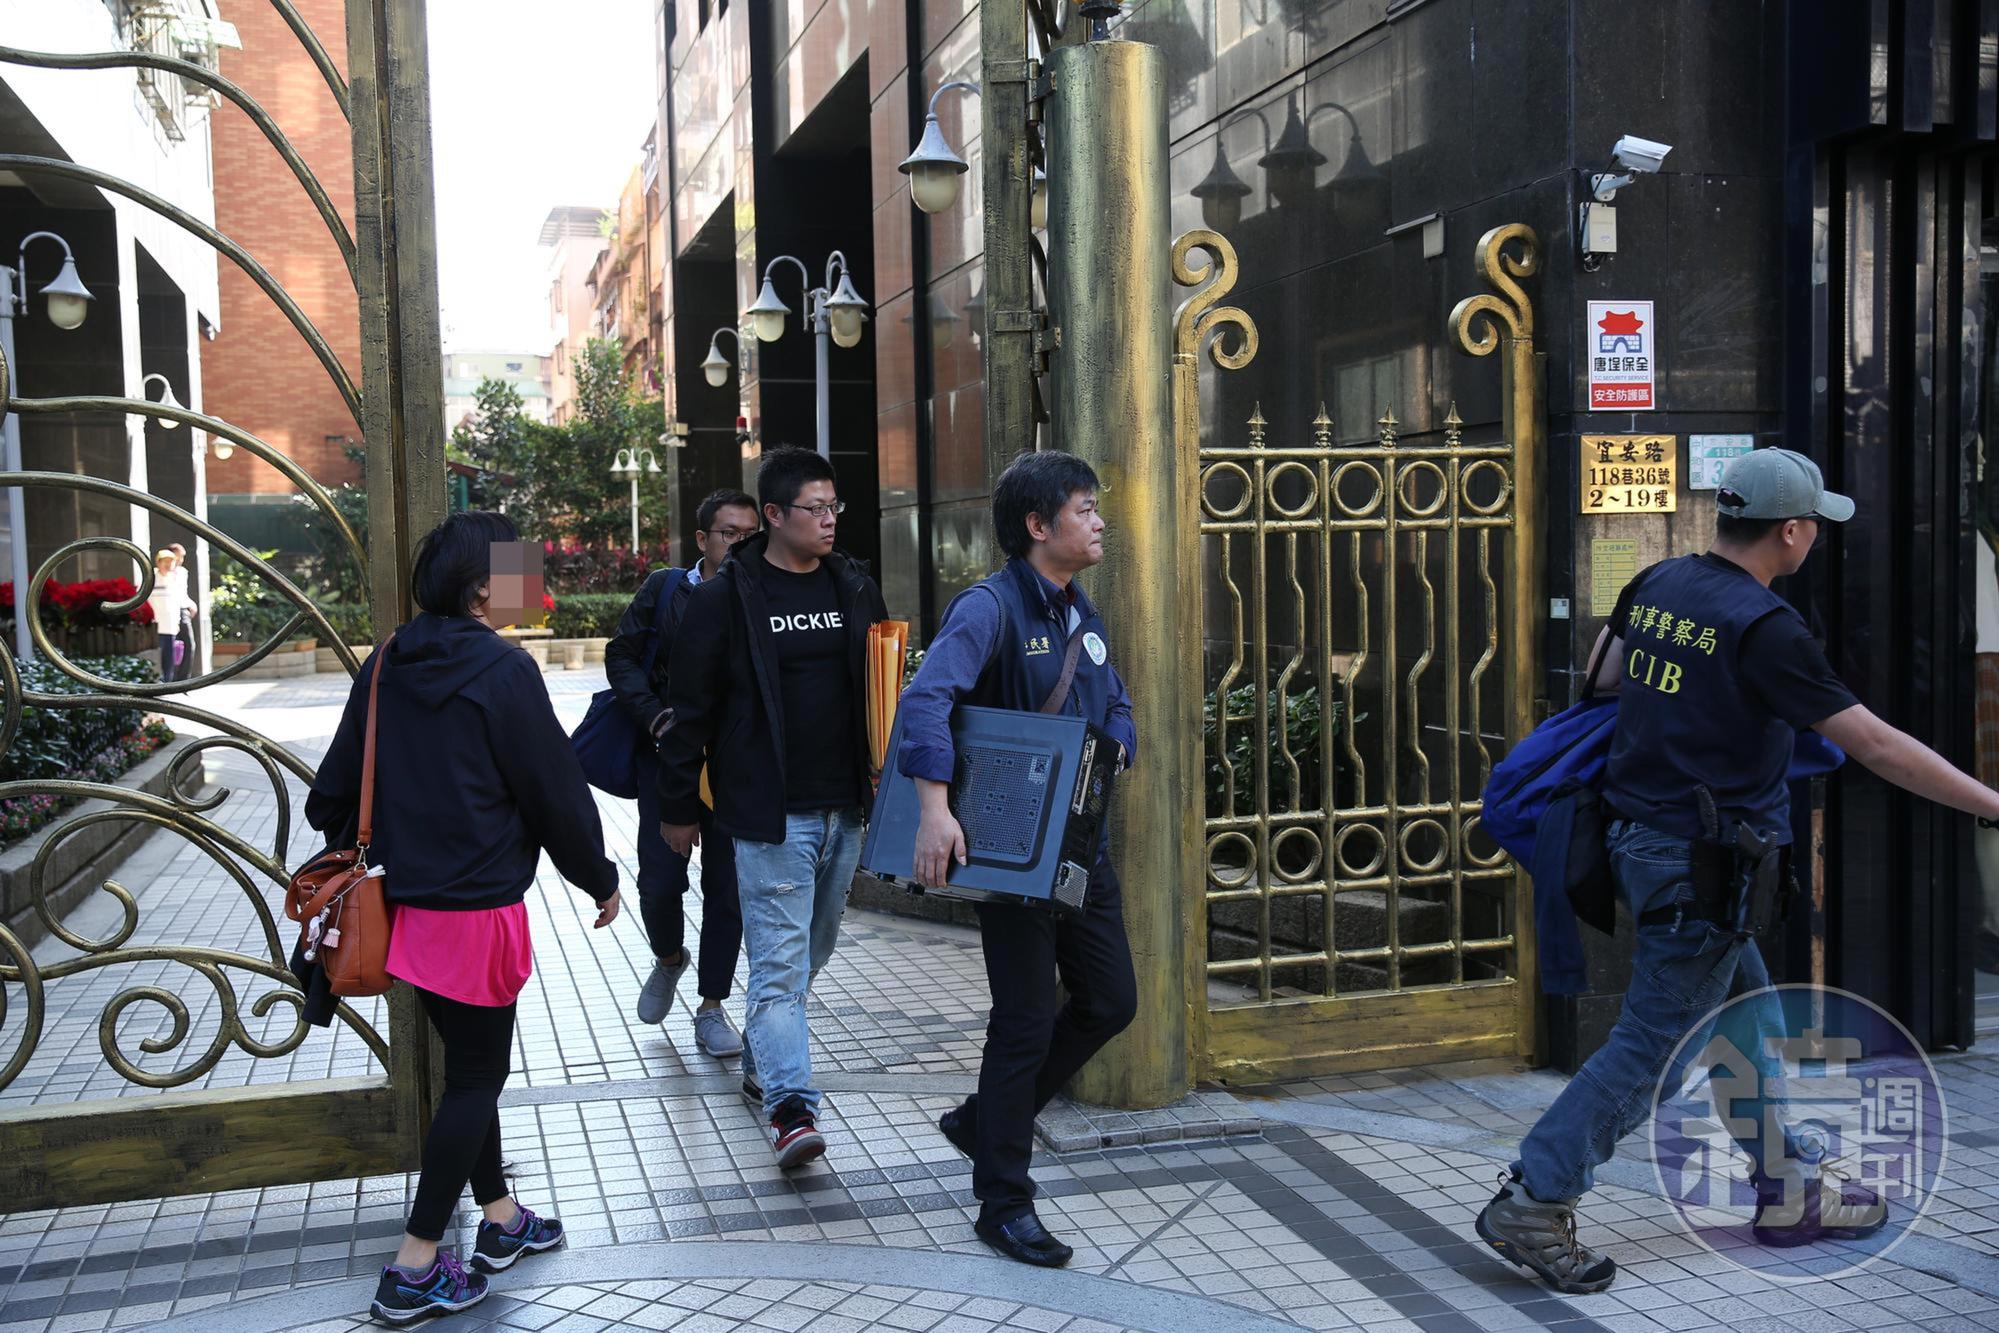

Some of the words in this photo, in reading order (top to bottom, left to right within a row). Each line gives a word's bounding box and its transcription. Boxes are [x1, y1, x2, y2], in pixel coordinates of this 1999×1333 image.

[1594, 357, 1649, 372] 唐埕保全
[1594, 389, 1649, 402] 安全防護區
[1597, 440, 1665, 463] 宜安路
[1589, 467, 1671, 486] 118巷36號
[769, 612, 844, 633] DICKIE
[1628, 604, 1718, 656] 刑事警察局
[1629, 648, 1684, 695] CIB
